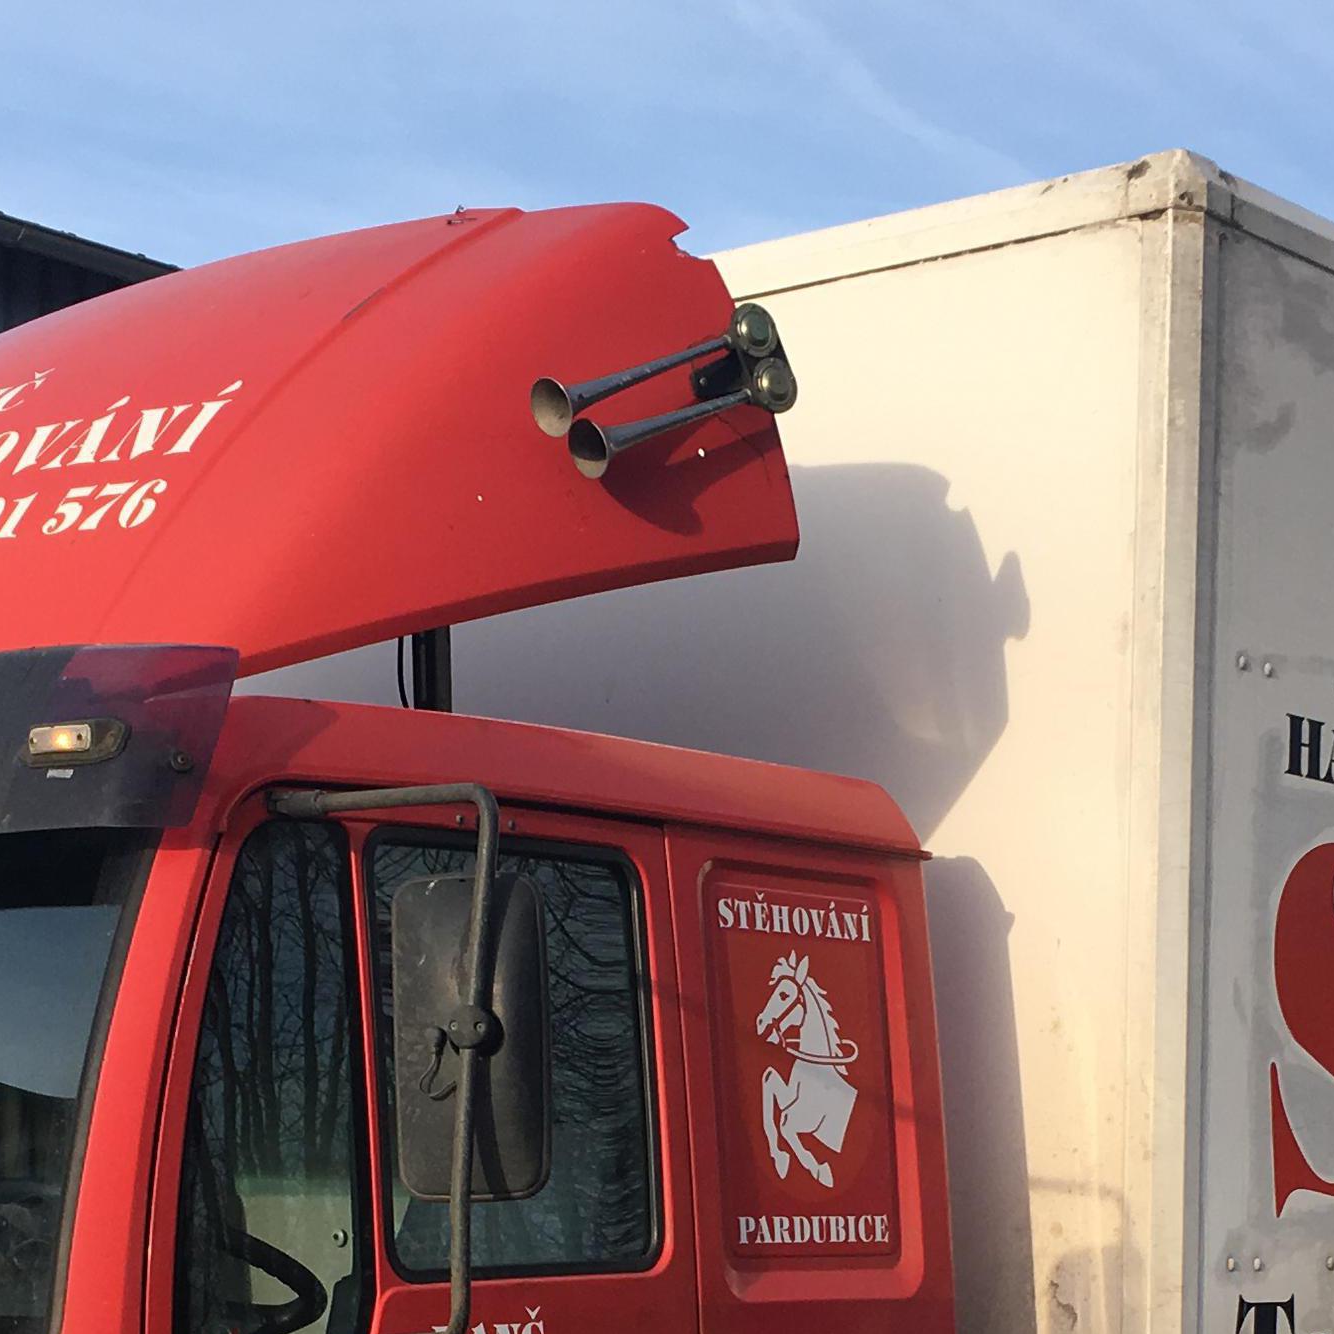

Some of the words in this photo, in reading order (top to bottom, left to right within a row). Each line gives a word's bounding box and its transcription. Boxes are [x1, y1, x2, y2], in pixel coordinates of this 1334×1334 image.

[42, 478, 167, 537] 576
[717, 892, 871, 942] STĚHOVÁNÍ
[738, 1214, 889, 1244] PARDUBICE
